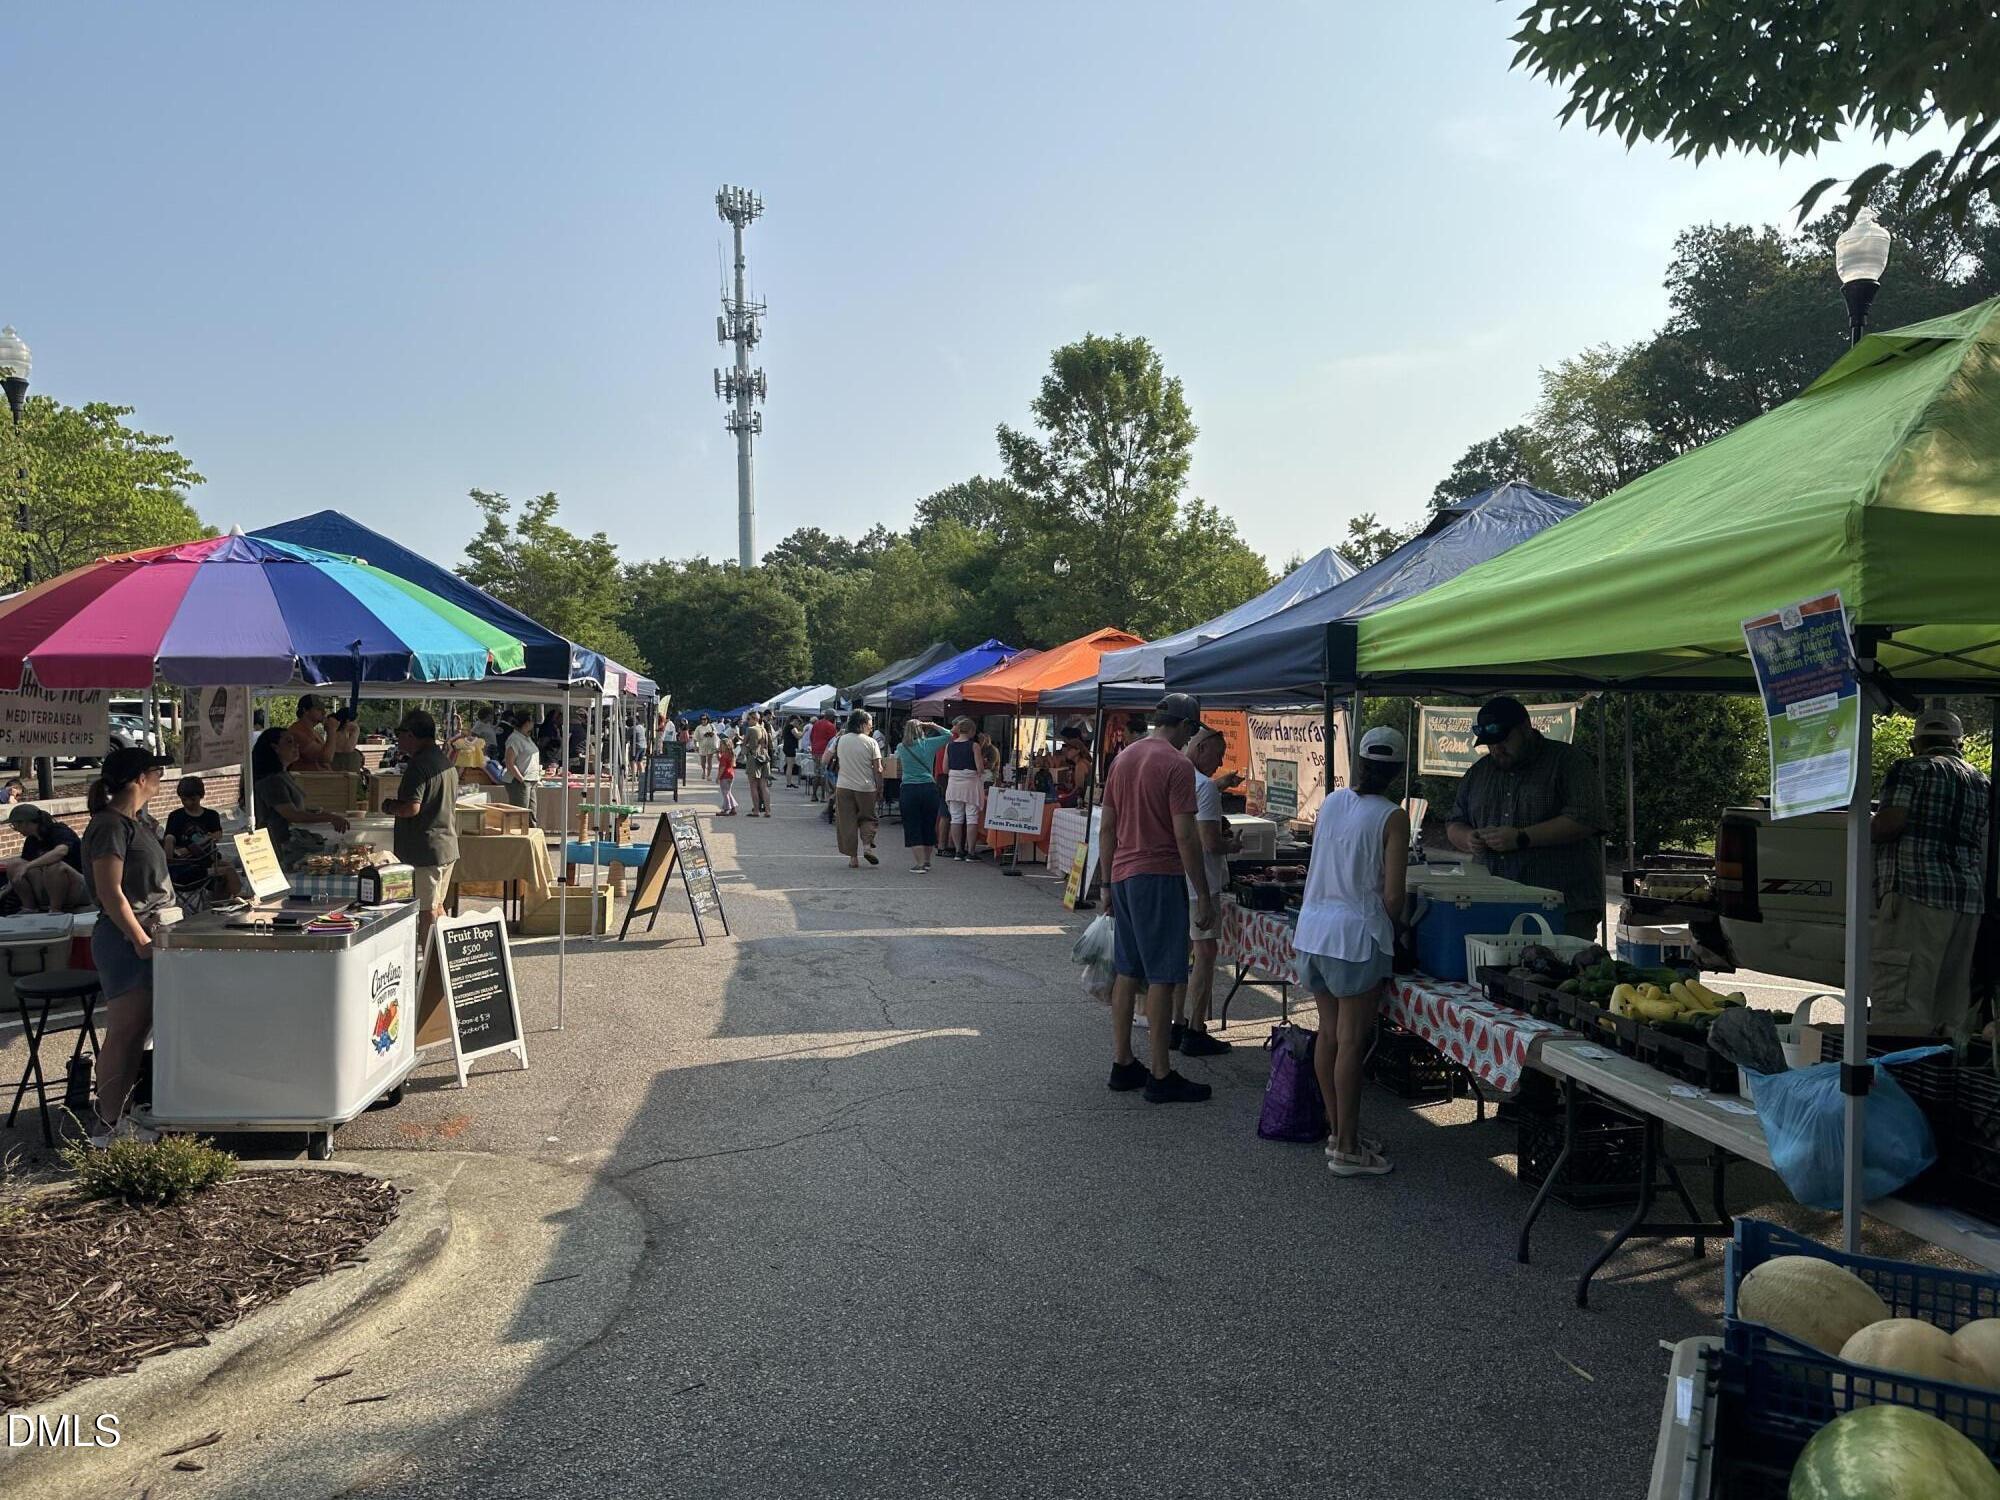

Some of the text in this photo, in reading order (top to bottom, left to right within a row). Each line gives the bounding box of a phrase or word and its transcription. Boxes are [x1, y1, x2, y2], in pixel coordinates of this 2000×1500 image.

[6, 709, 82, 726] MEDITERRANEAN
[20, 730, 58, 744] HUMMUS
[61, 732, 67, 744] &
[69, 733, 95, 745] CHIPS
[447, 926, 495, 944] Fruit Pops
[371, 961, 402, 999] Carolina
